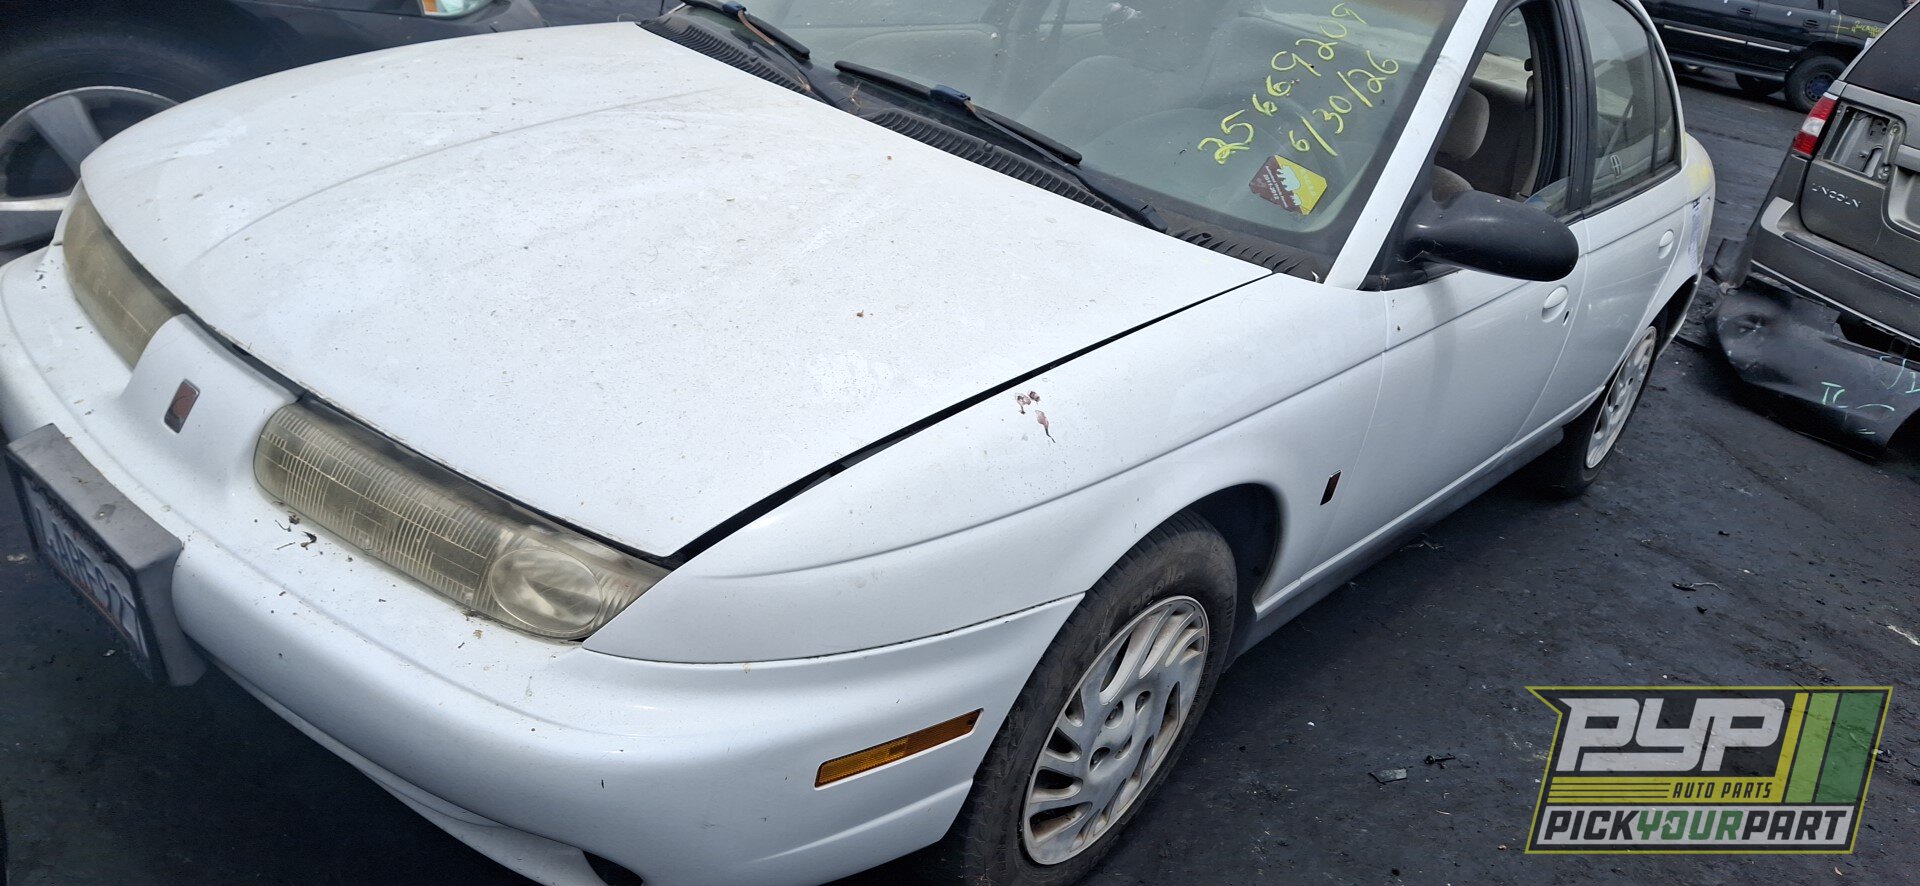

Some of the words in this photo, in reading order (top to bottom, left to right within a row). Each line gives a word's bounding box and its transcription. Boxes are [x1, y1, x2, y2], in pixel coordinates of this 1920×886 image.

[1197, 3, 1367, 164] 25669209
[1289, 50, 1398, 156] 6/30/26
[1812, 183, 1861, 208] LNCOLN
